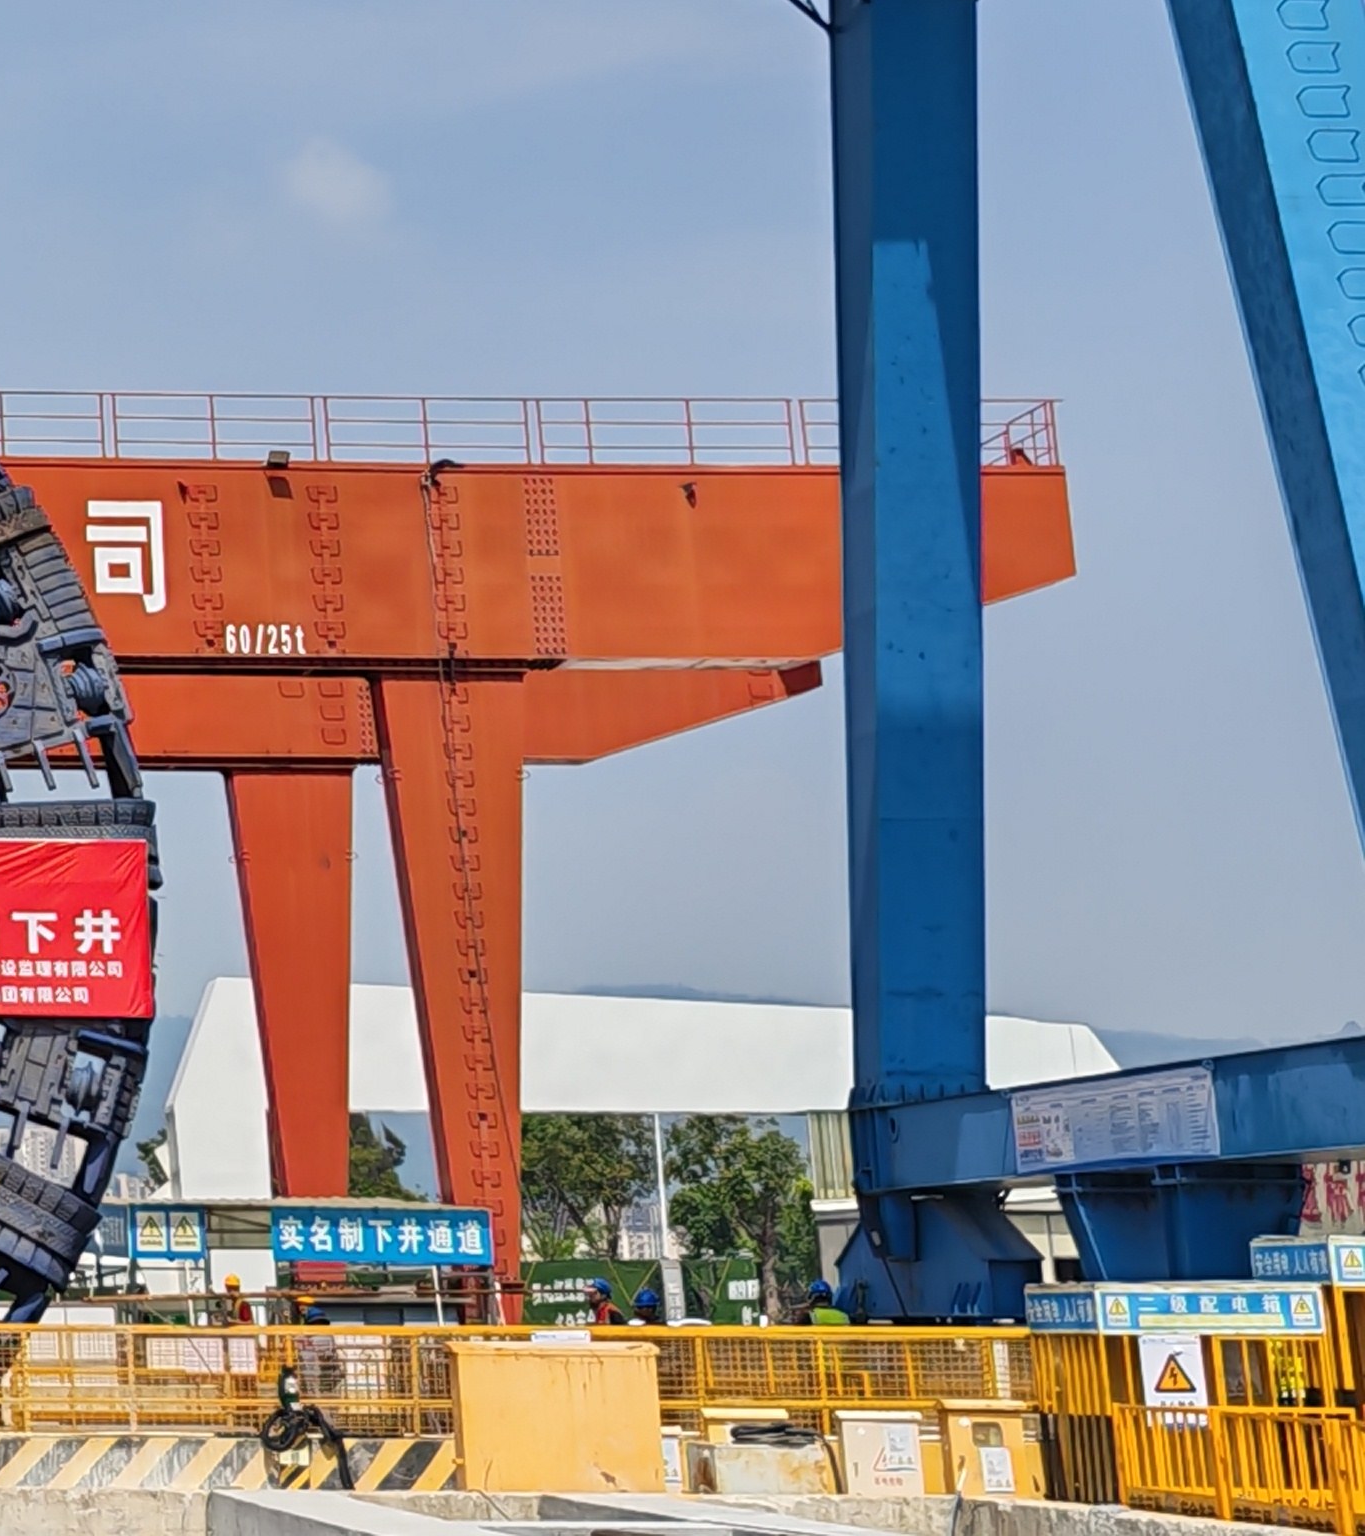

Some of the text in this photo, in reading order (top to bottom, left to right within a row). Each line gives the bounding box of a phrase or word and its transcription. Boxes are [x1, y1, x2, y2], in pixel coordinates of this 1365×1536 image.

[86, 500, 167, 613] 司
[225, 624, 307, 655] 60/25t
[278, 1215, 484, 1255] 实名制下井通道
[1137, 1294, 1281, 1314] 二级配电箱
